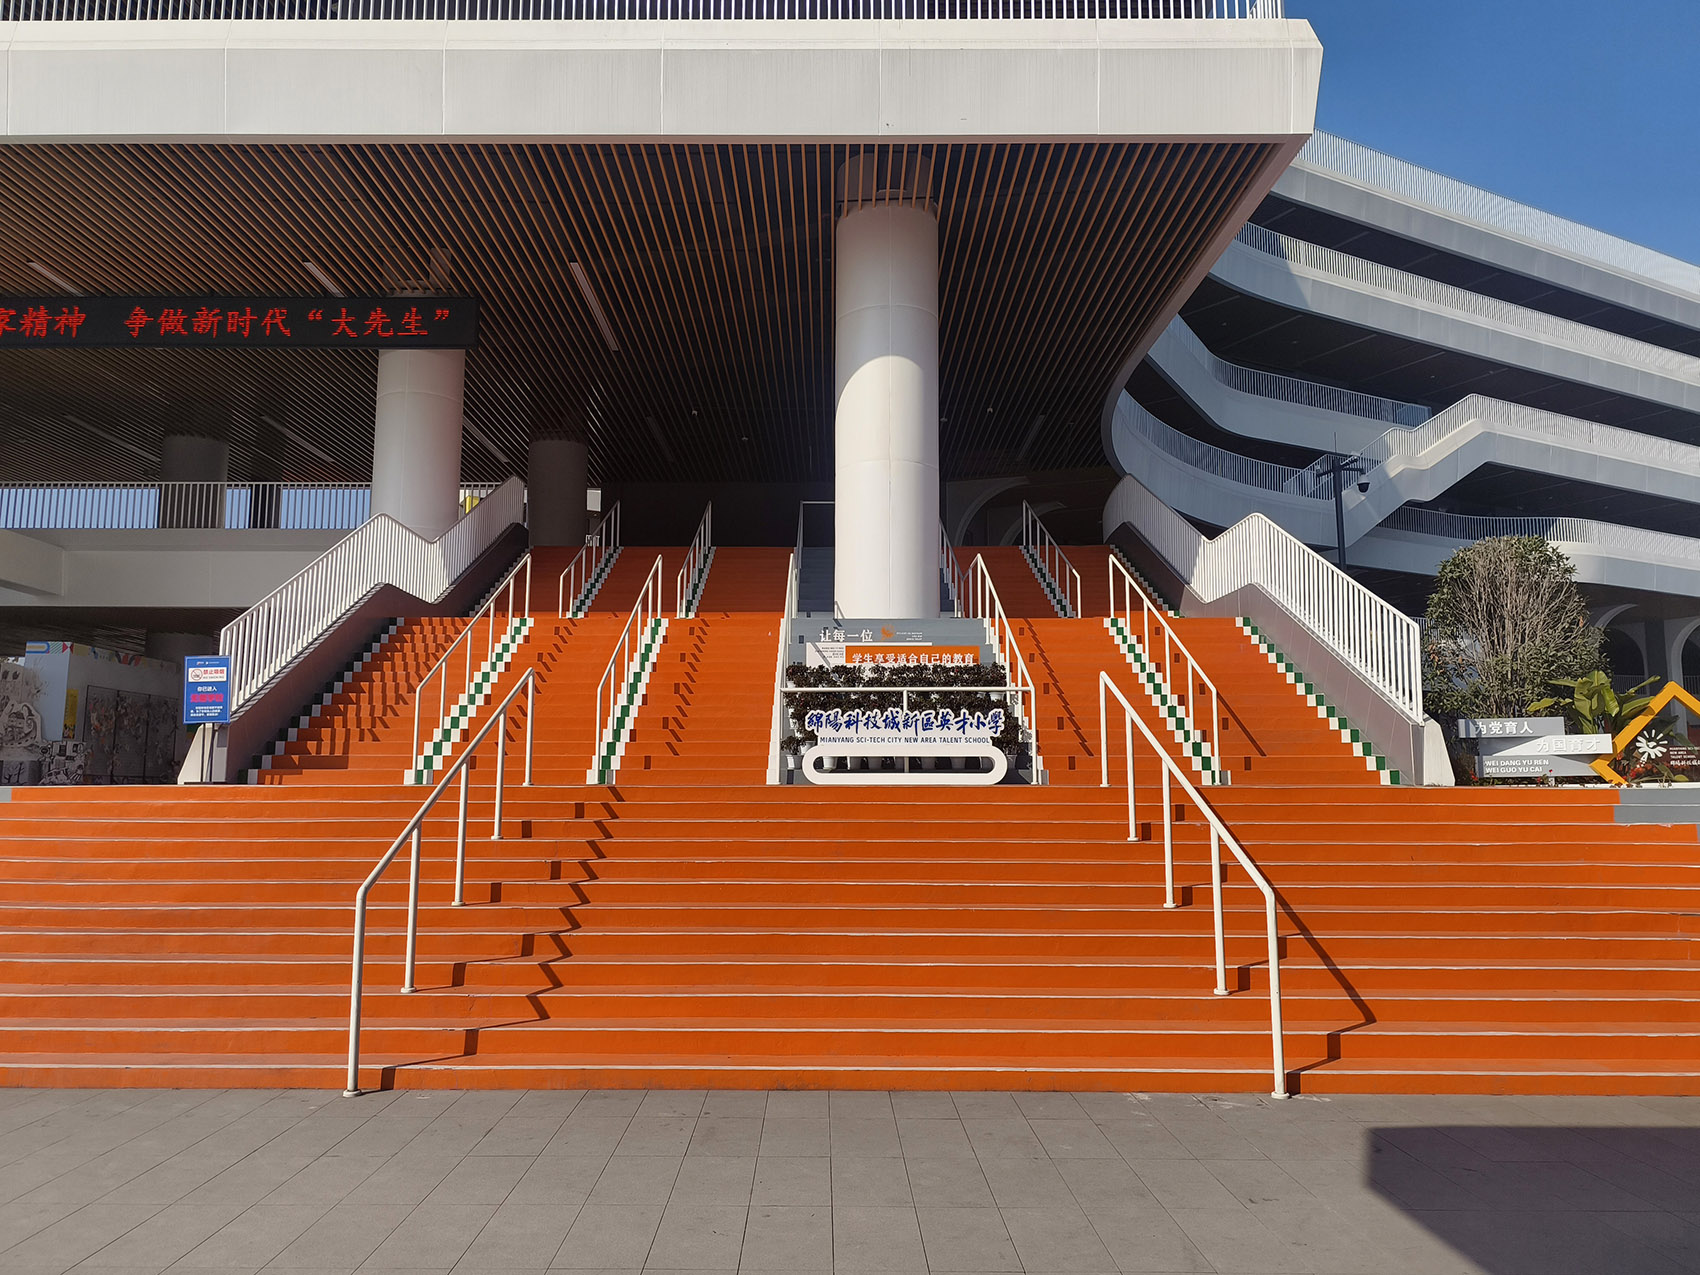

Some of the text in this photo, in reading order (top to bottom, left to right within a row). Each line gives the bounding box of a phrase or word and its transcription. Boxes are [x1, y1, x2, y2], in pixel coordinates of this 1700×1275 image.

[819, 629, 873, 642] 让每一位
[852, 653, 975, 664] 学生享受适合自己的教育
[1475, 720, 1533, 735] 为党育人
[1537, 737, 1601, 753] 为国育才
